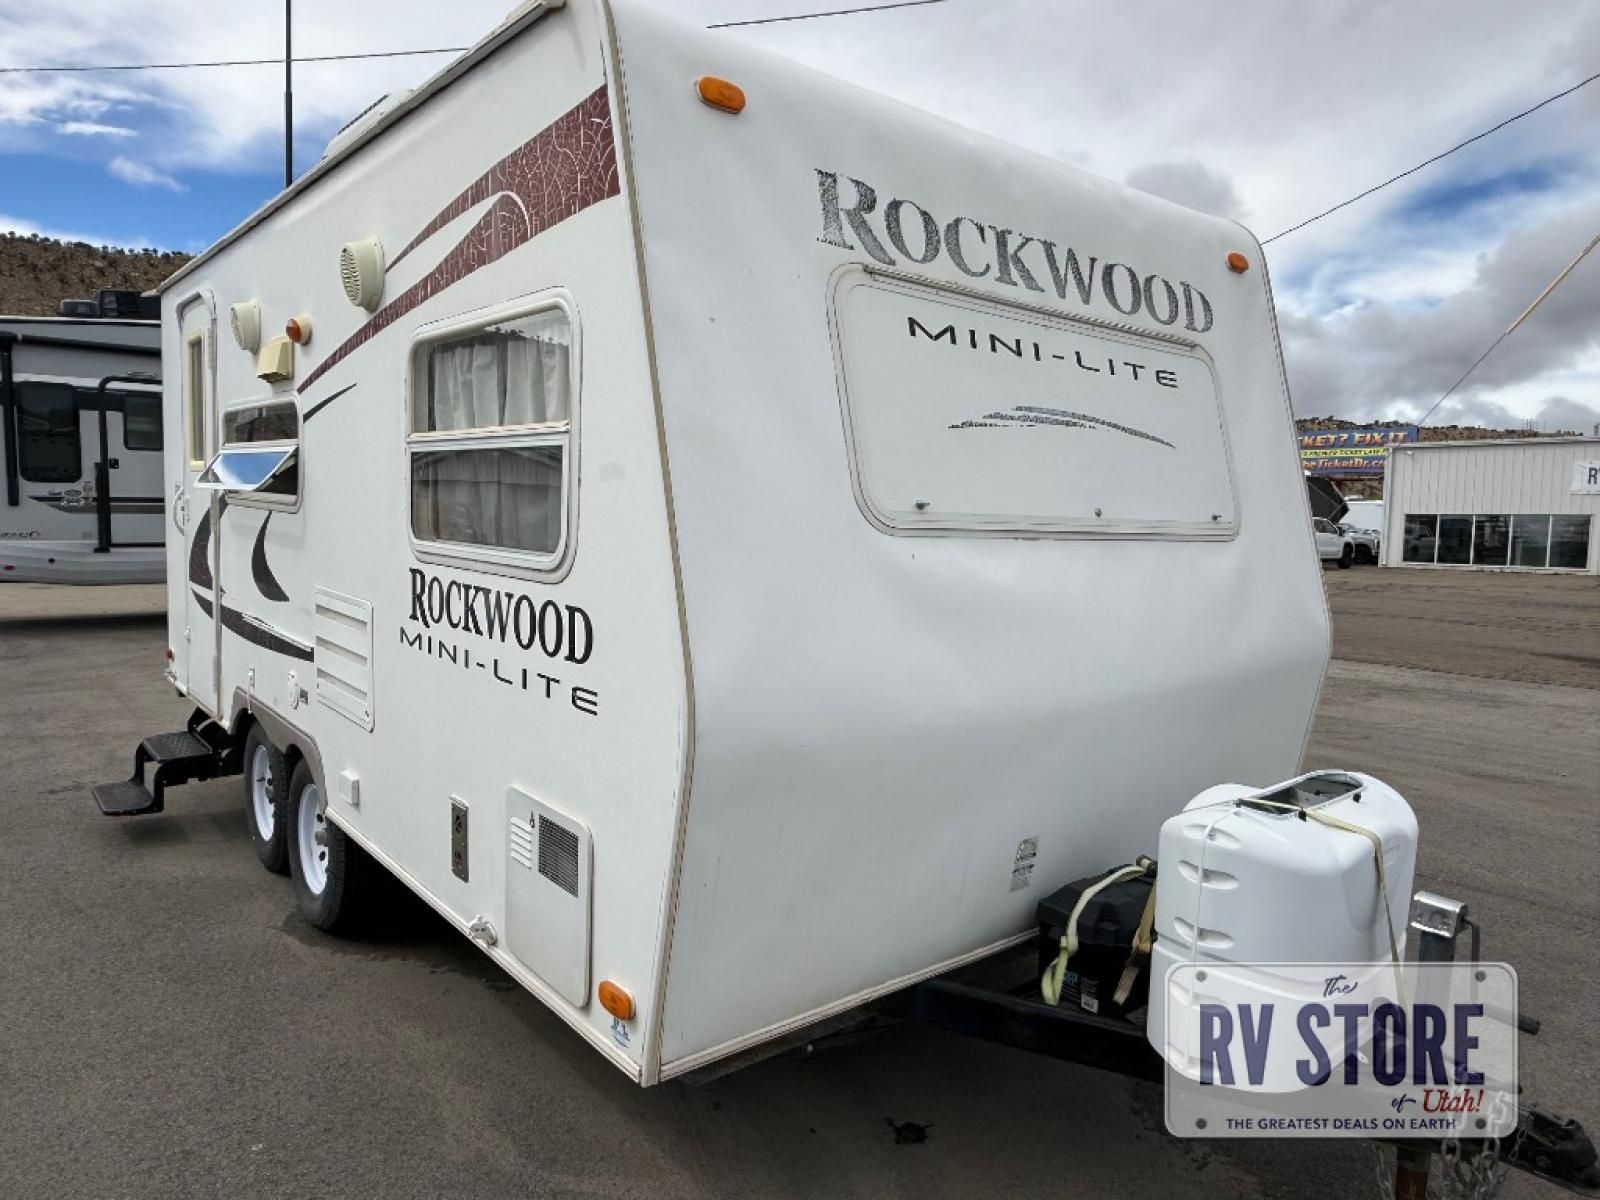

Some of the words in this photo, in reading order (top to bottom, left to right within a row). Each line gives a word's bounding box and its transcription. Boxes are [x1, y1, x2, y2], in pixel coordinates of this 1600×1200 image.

[813, 168, 1215, 333] ROCKWOOD
[907, 316, 1180, 389] MINI-LITE
[1352, 432, 1385, 446] FIX
[1388, 431, 1409, 445] IT
[408, 567, 594, 665] ROCKWOOD
[400, 626, 598, 716] MINI-LITE
